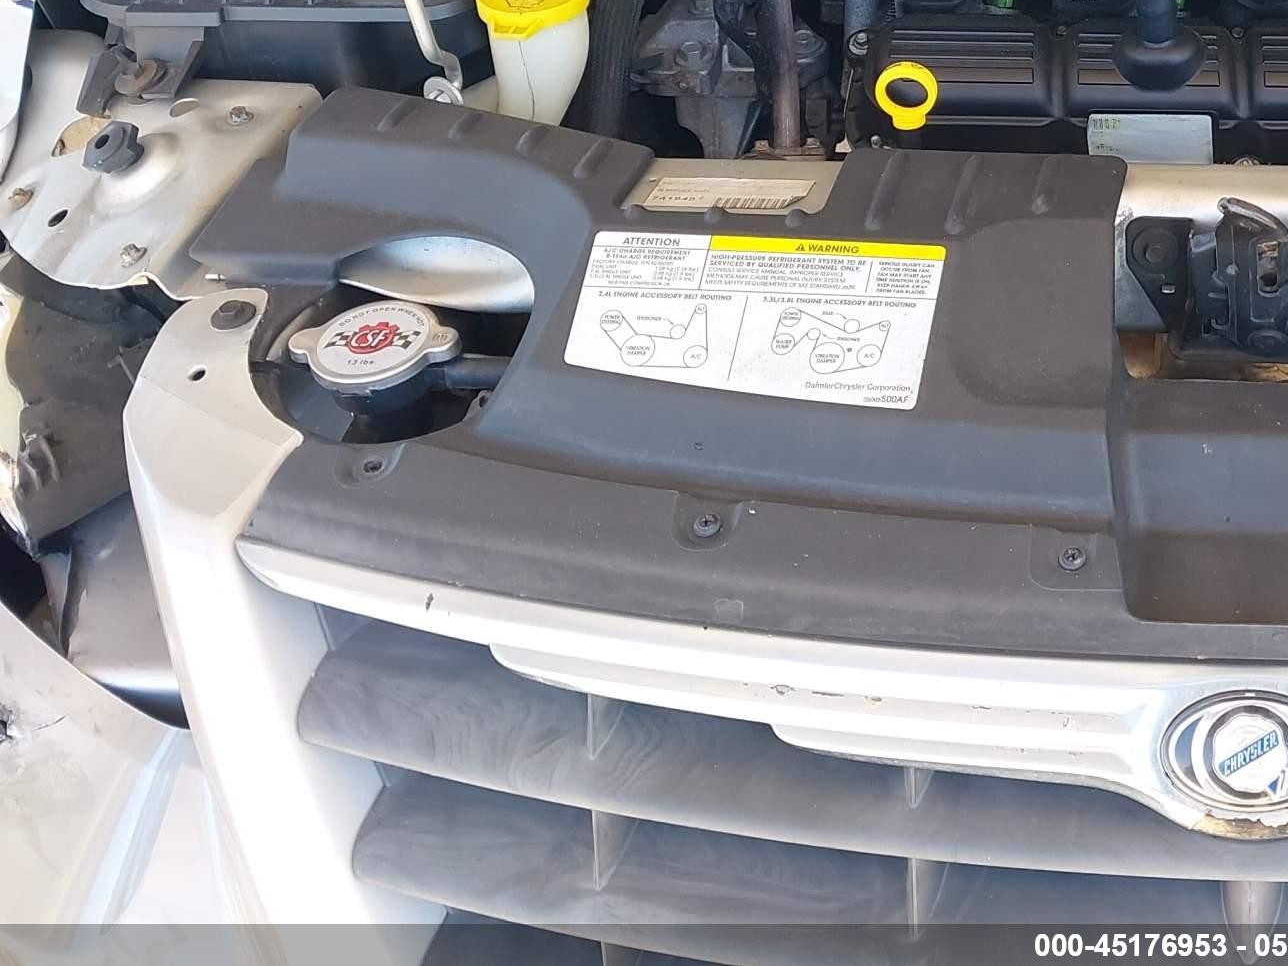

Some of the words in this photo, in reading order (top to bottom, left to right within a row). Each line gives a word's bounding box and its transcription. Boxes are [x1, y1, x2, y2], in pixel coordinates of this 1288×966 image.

[623, 237, 680, 246] ATTENTION
[808, 244, 860, 254] WARNING
[340, 318, 351, 326] DO
[352, 311, 369, 320] NOT
[398, 307, 416, 318] WHEN
[351, 330, 389, 346] CSF
[805, 381, 865, 392] DaimlerChrysler
[1224, 731, 1278, 776] CHRYSLER
